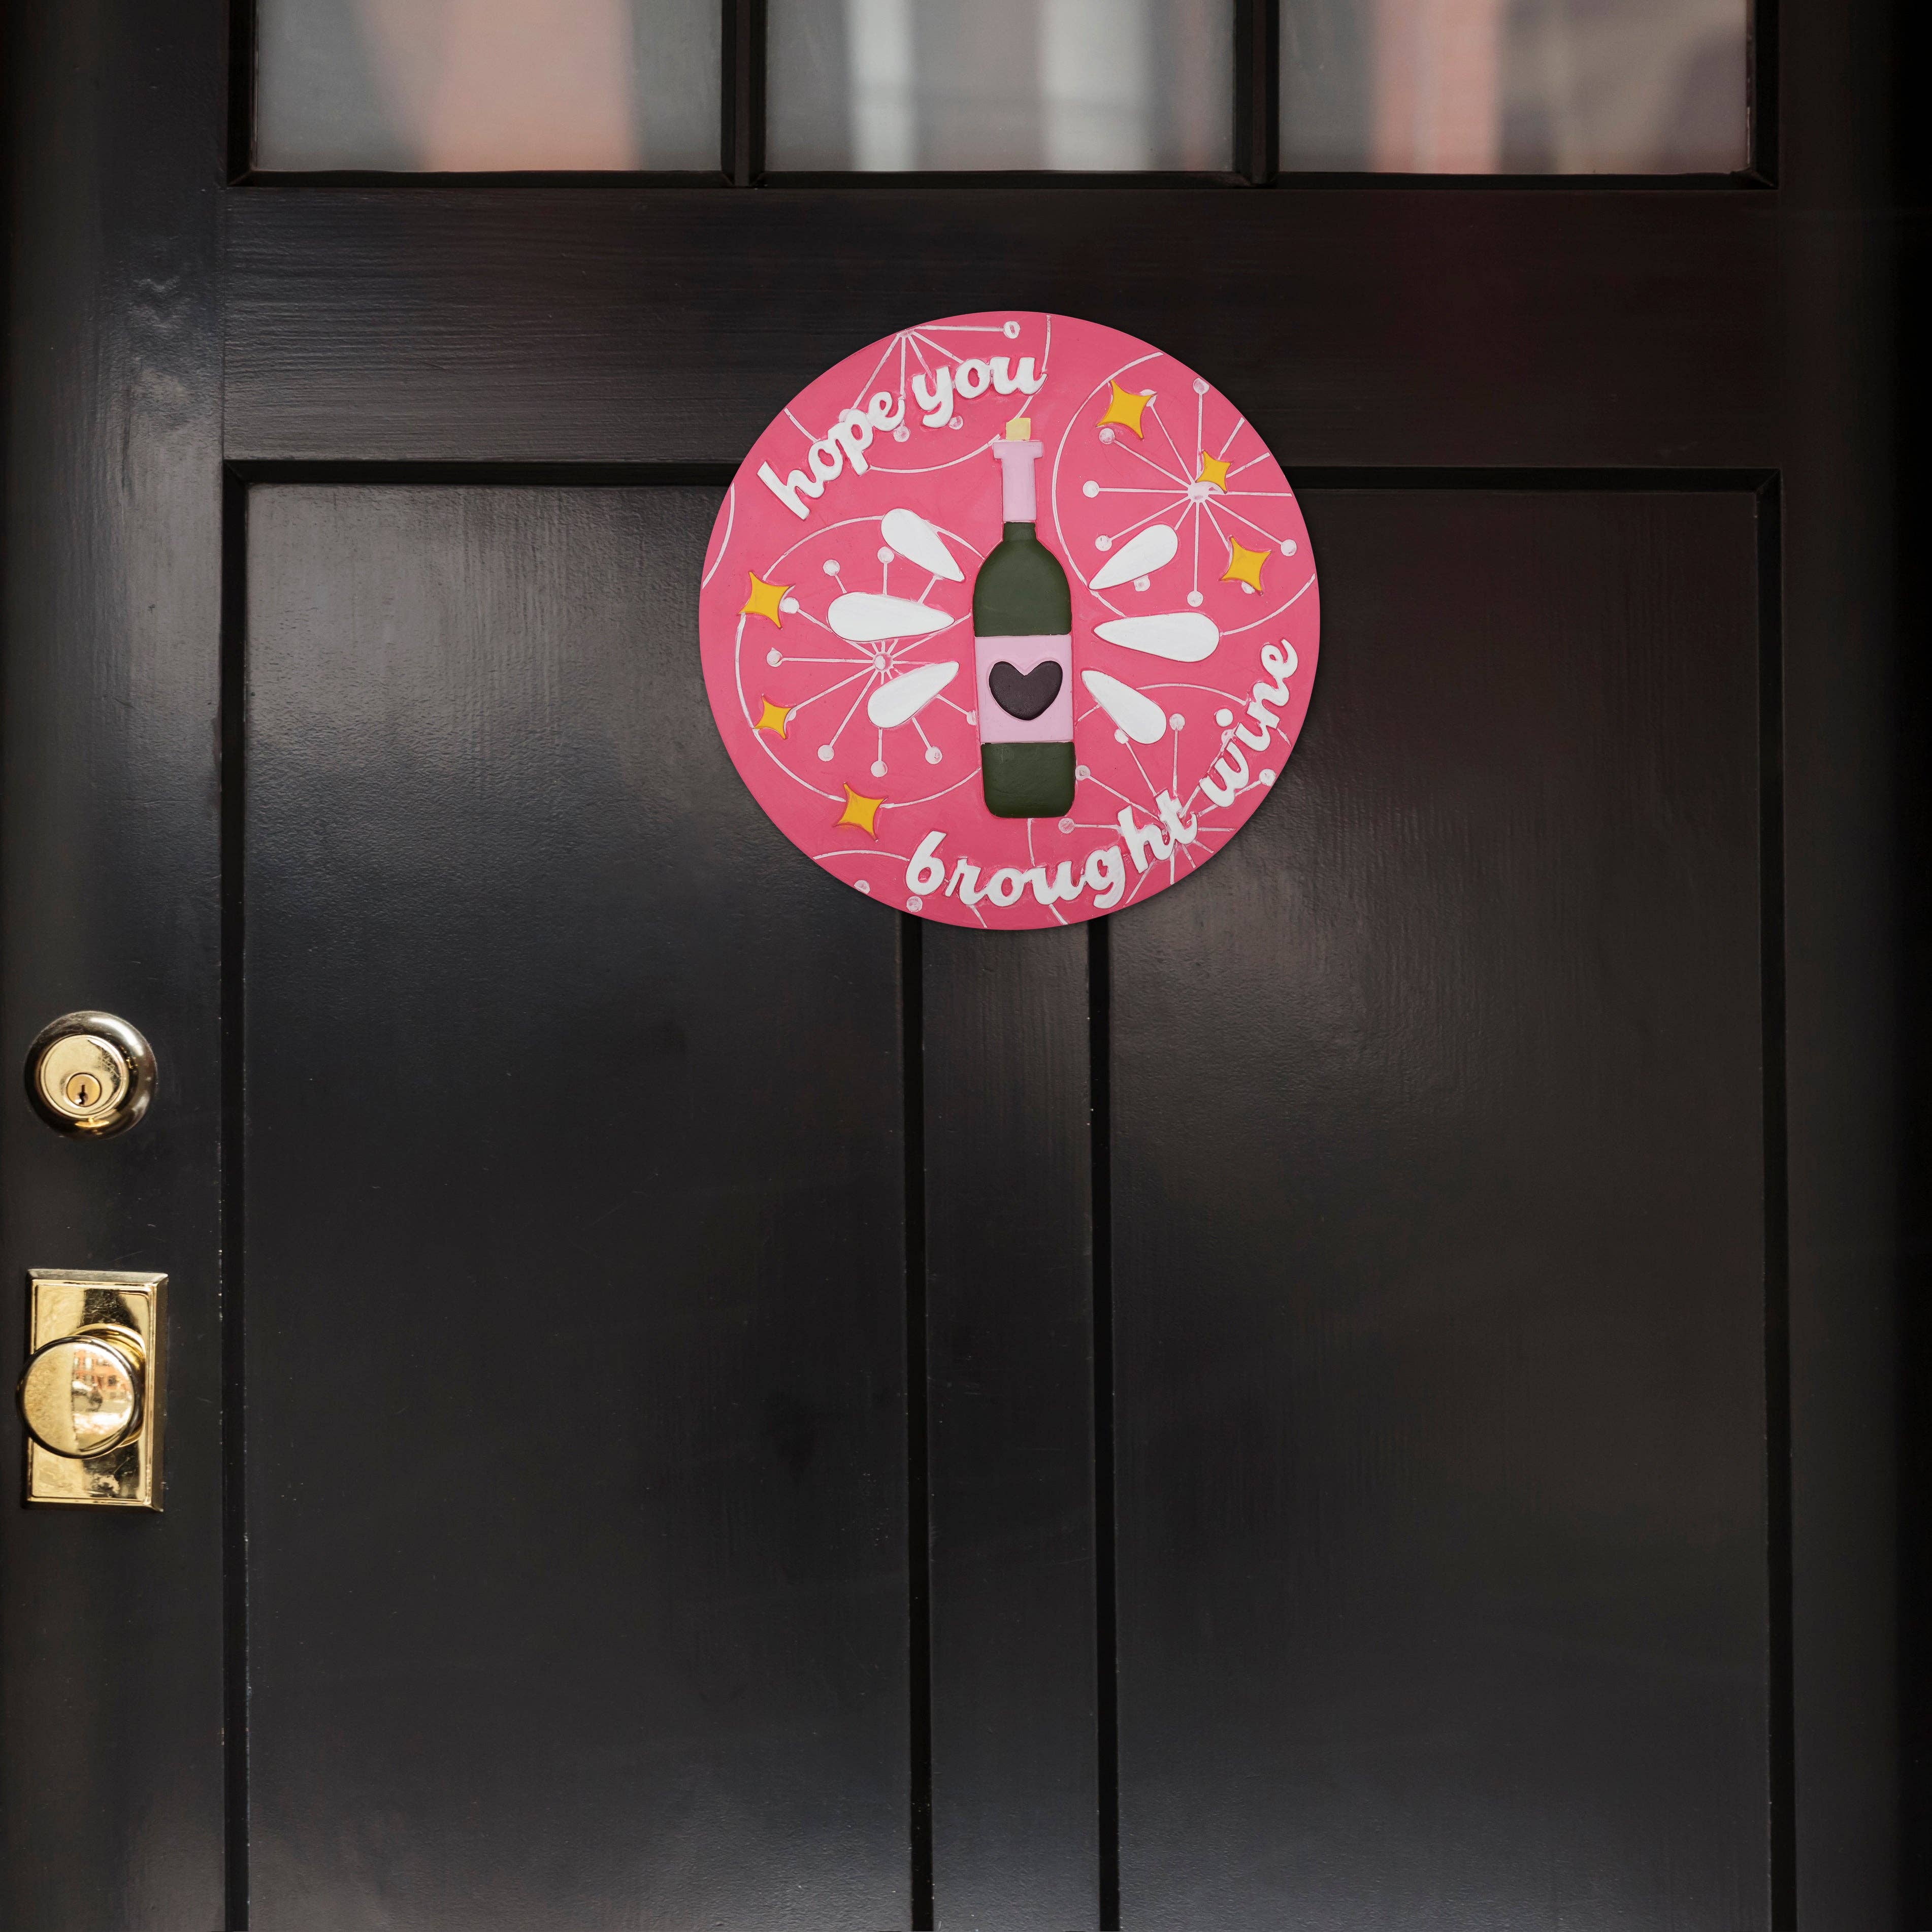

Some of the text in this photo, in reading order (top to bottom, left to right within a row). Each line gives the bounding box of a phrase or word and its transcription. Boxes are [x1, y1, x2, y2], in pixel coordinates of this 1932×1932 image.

[758, 357, 1047, 520] hope you
[906, 639, 1298, 908] brought wine
